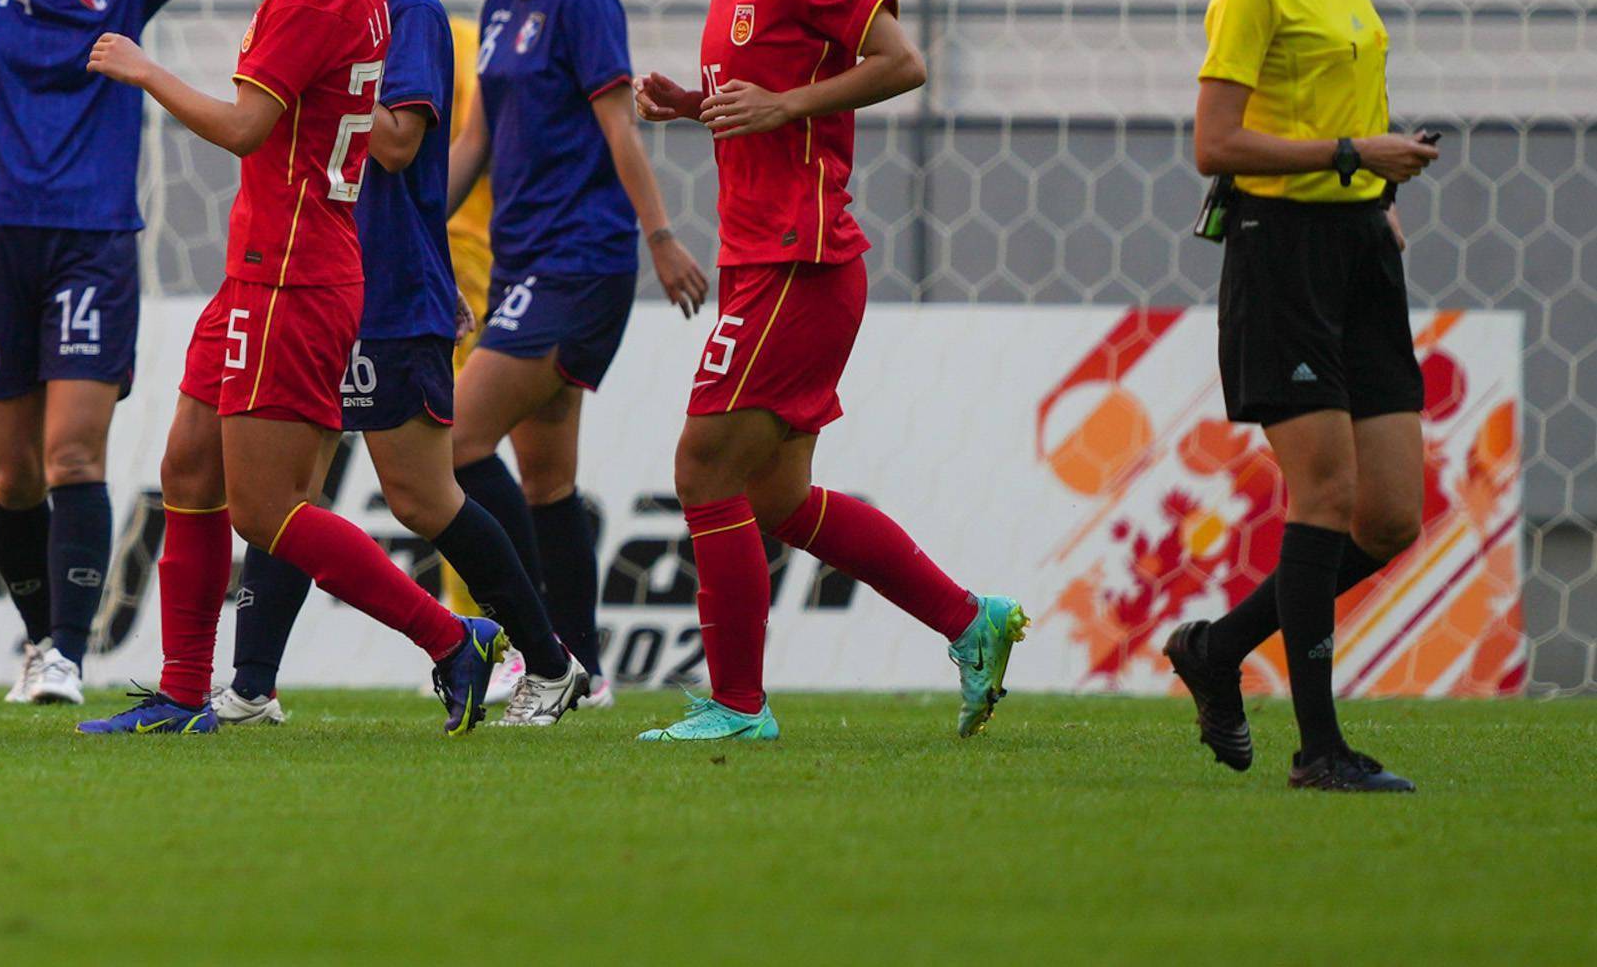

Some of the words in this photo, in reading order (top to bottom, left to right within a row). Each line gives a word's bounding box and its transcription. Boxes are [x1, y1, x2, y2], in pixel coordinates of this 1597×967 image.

[326, 61, 385, 202] 2
[55, 286, 101, 342] 14
[225, 308, 250, 369] 5
[703, 314, 744, 375] 5
[343, 397, 374, 407] ENTES
